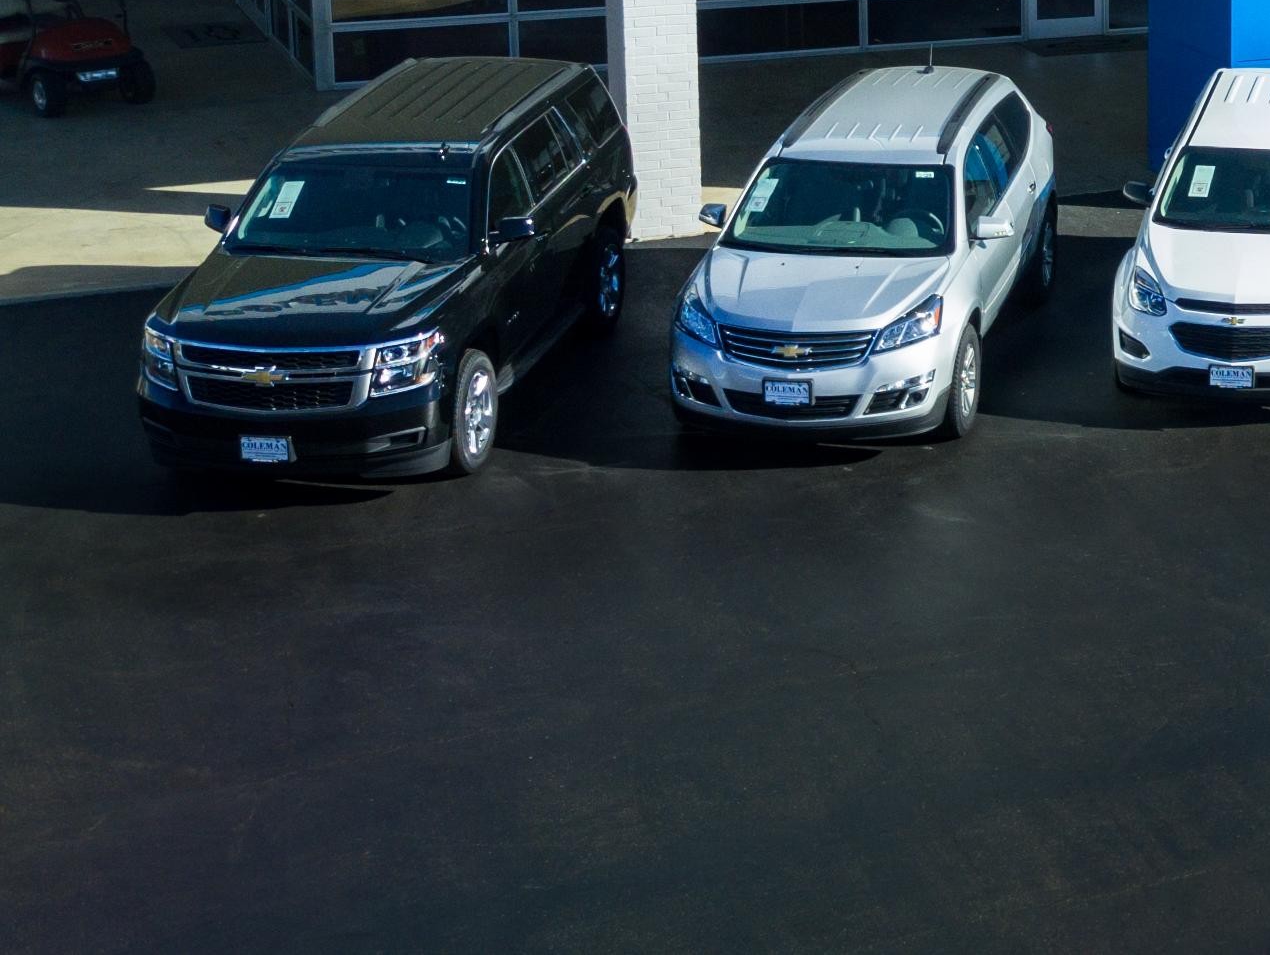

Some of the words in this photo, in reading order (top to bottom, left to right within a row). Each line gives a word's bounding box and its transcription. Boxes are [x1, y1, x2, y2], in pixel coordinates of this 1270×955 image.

[1211, 369, 1251, 378] COLEMAN
[765, 384, 809, 394] COLEMAN
[242, 441, 287, 452] COLEMAN
